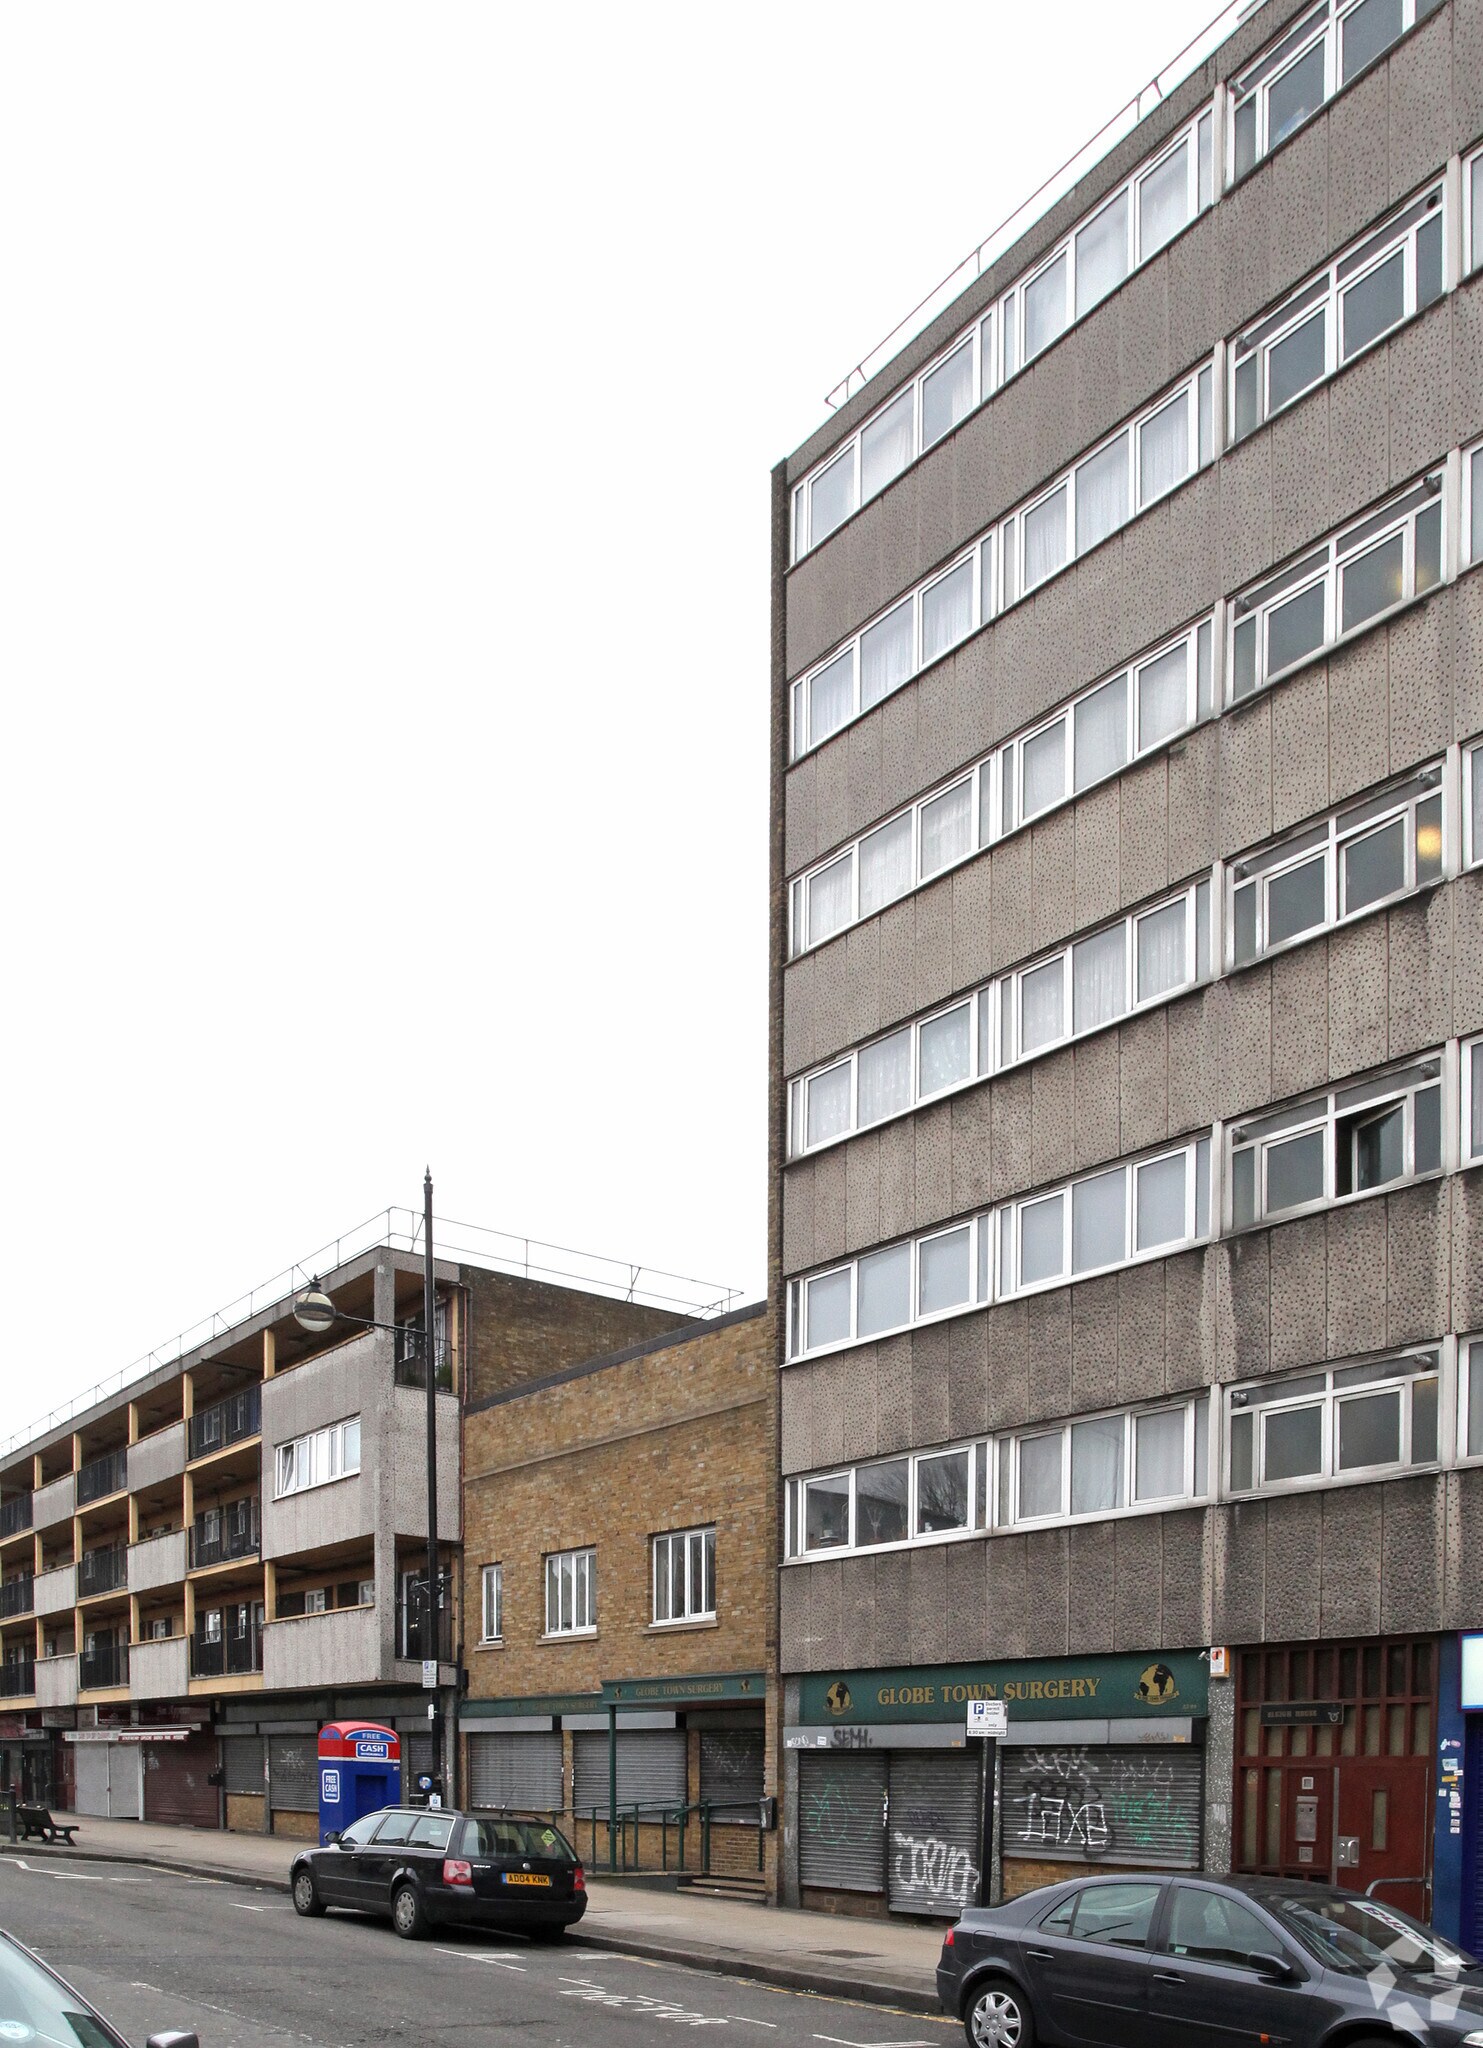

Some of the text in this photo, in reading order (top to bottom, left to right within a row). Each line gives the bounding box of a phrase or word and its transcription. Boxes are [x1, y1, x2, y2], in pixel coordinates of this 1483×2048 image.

[635, 1682, 723, 1697] GLOBE TOWN SURGERY
[877, 1677, 1100, 1705] GLOBE TOWN SURGERY
[360, 1745, 384, 1753] CASH
[325, 1775, 337, 1784] FREE
[325, 1784, 338, 1793] CASH
[508, 1874, 548, 1884] AD04 KNK
[558, 1989, 729, 2026] DOCTOR
